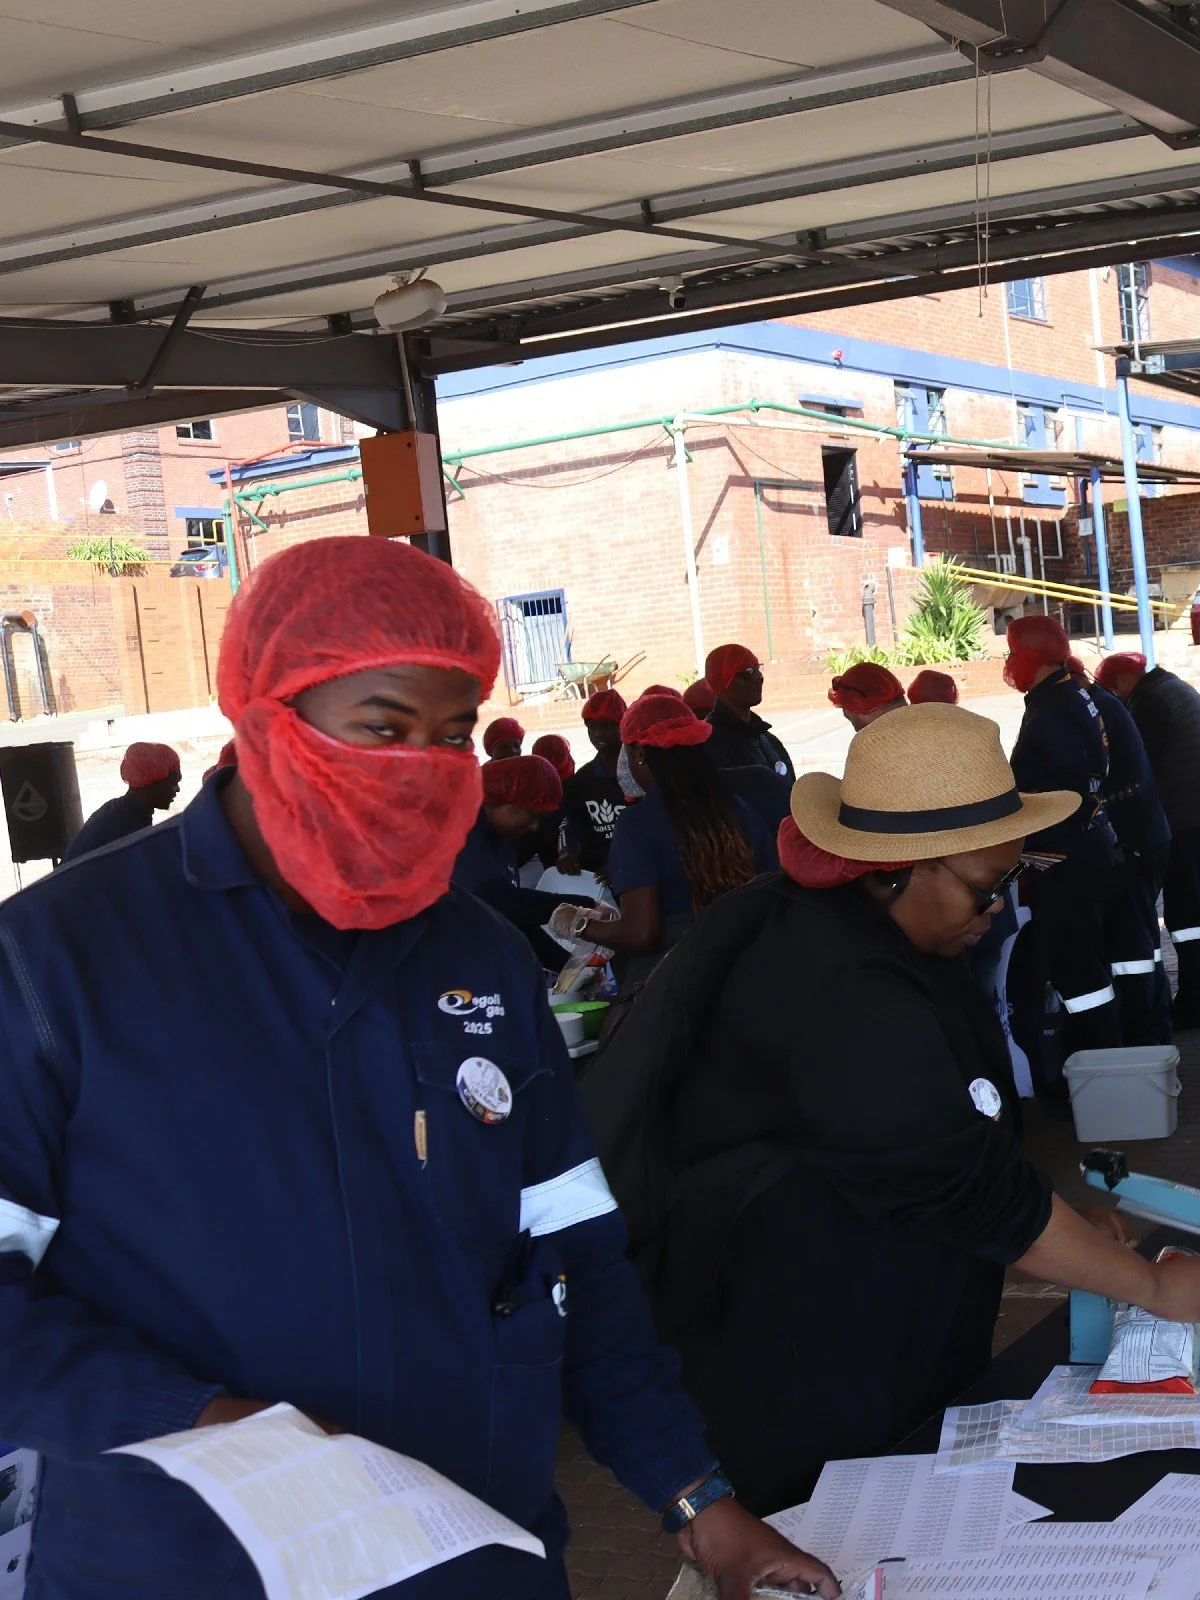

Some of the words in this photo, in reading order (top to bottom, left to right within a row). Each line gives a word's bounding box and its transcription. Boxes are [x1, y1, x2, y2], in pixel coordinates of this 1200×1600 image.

[472, 994, 500, 1008] egoli
[486, 1006, 505, 1018] gas
[463, 1021, 493, 1035] 2025
